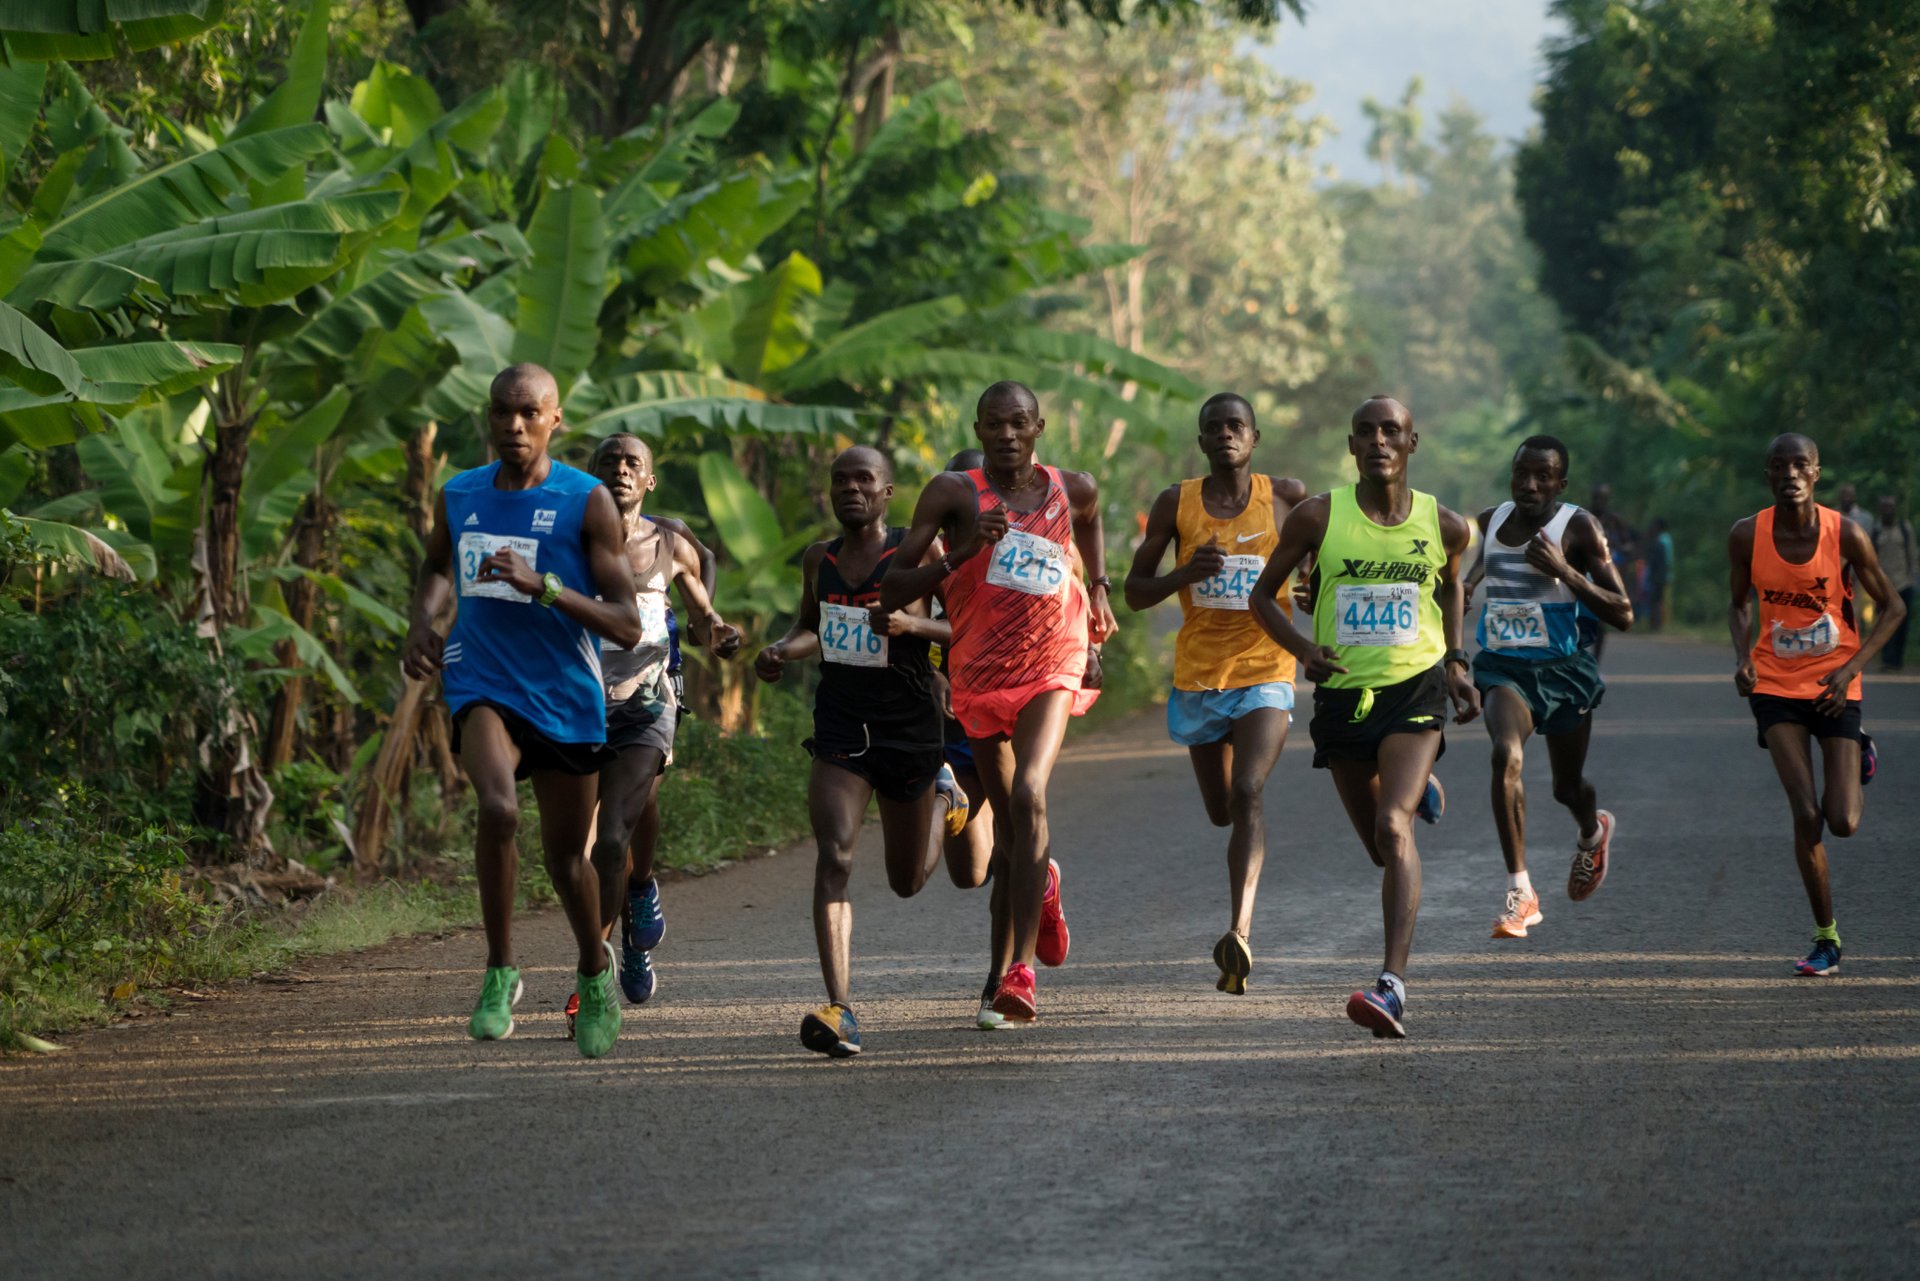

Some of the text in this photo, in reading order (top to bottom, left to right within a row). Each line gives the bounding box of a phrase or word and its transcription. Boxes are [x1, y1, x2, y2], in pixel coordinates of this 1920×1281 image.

[998, 546, 1063, 585] 4215
[1239, 557, 1260, 566] 21km
[1390, 586, 1413, 597] 21km
[1343, 600, 1413, 632] 4446
[823, 620, 882, 654] 4216
